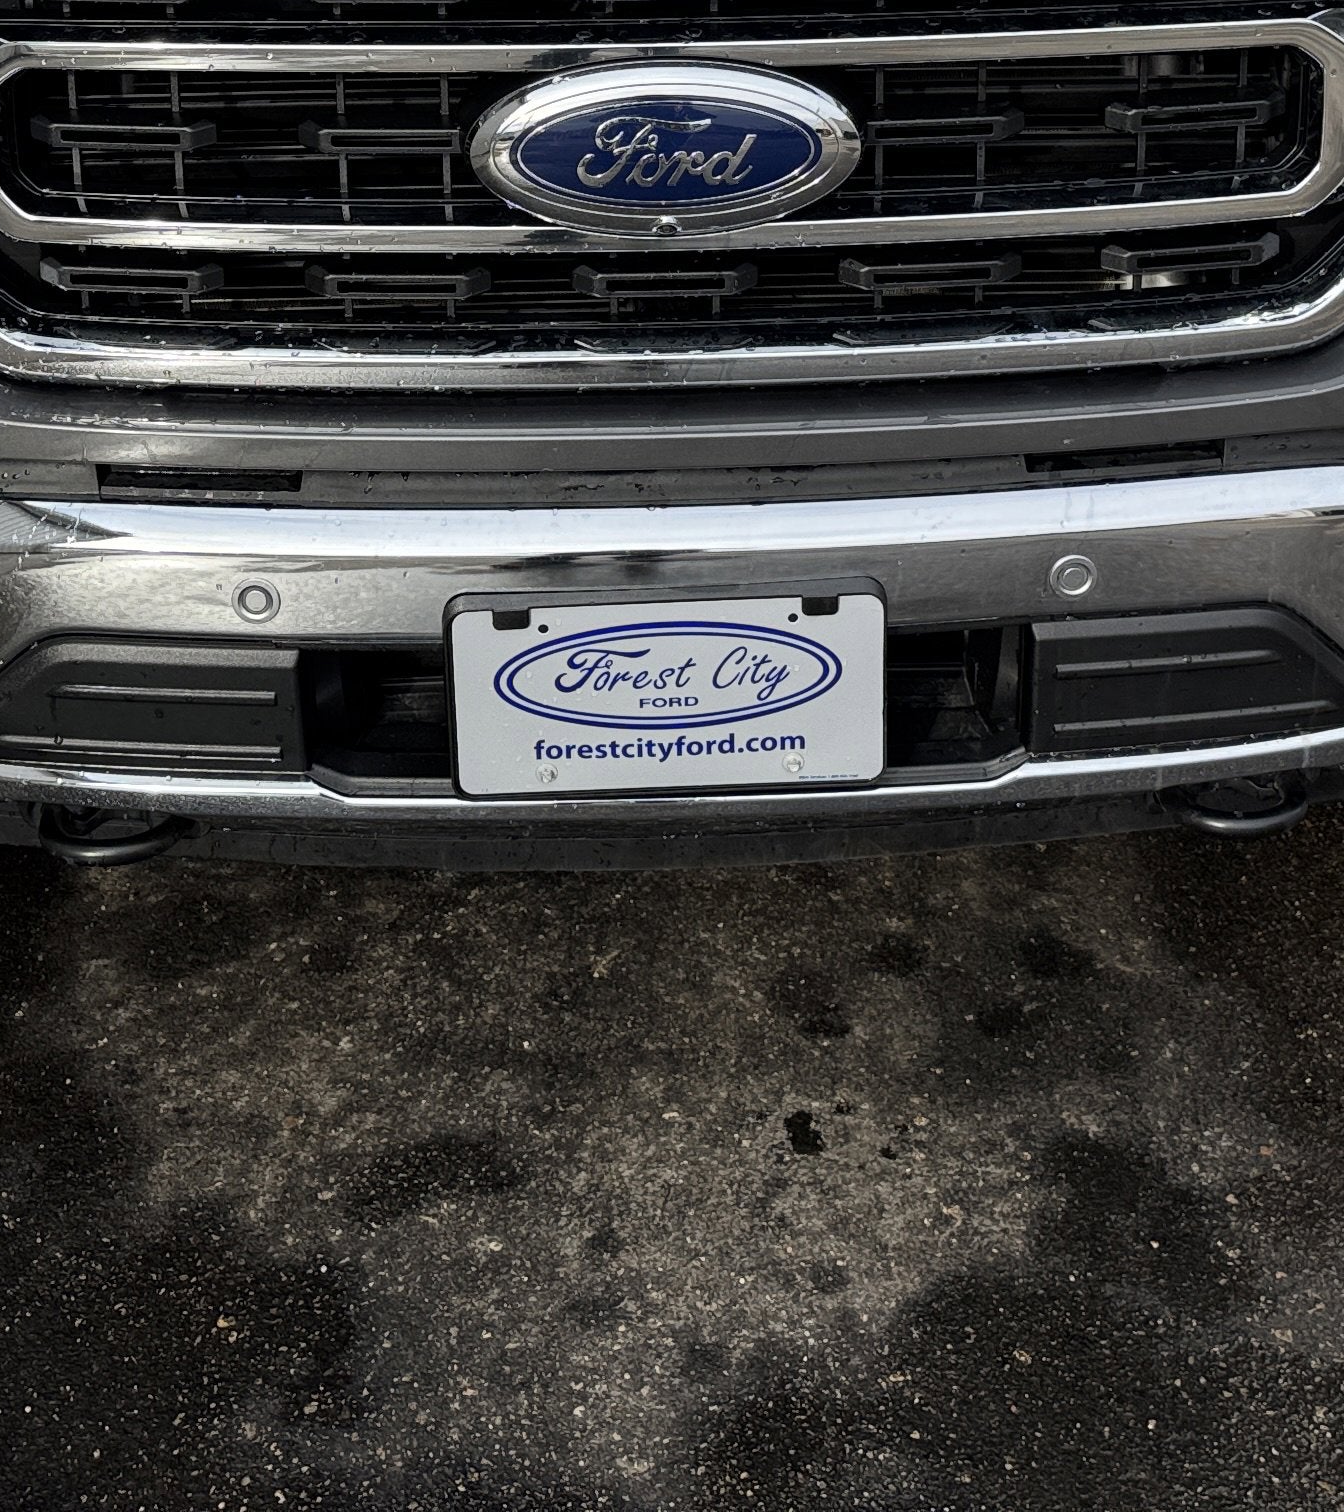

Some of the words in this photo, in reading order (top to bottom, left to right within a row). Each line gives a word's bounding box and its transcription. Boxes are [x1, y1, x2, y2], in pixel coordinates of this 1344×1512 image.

[576, 116, 757, 187] Ford
[555, 648, 697, 693] Forest
[712, 646, 791, 701] City
[638, 695, 700, 709] FORD
[534, 733, 806, 763] forestcityford.com
